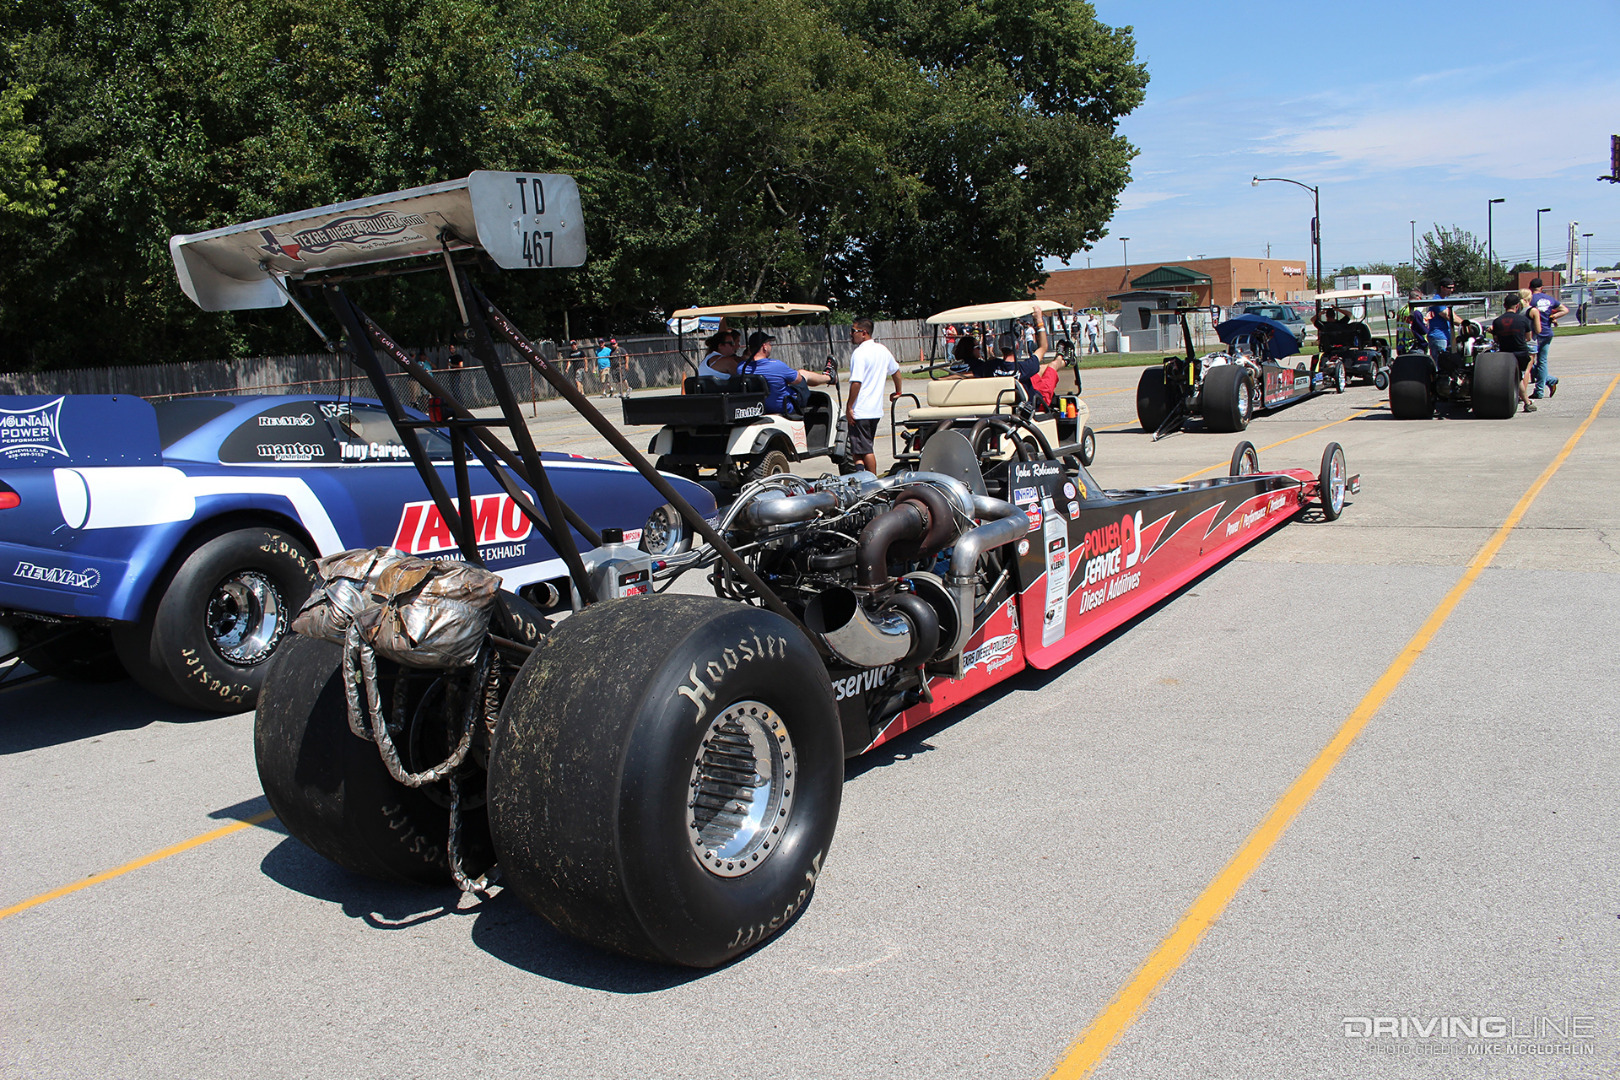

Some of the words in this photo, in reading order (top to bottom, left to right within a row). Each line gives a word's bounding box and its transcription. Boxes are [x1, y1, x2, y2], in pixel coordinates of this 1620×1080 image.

[294, 230, 329, 248] TEXAS
[327, 223, 363, 241] DIESEL
[522, 230, 554, 267] 467
[1, 427, 50, 438] POWER
[257, 441, 326, 457] manton
[340, 441, 368, 461] Tony
[1015, 464, 1031, 484] John
[1032, 462, 1060, 478] Robinson
[487, 543, 527, 561] EXHAUST
[1084, 521, 1121, 560] POWER
[1080, 545, 1122, 589] SERVICE
[1079, 581, 1108, 616] Diesel
[1106, 571, 1141, 603] Additives
[678, 626, 788, 725] Hoosier
